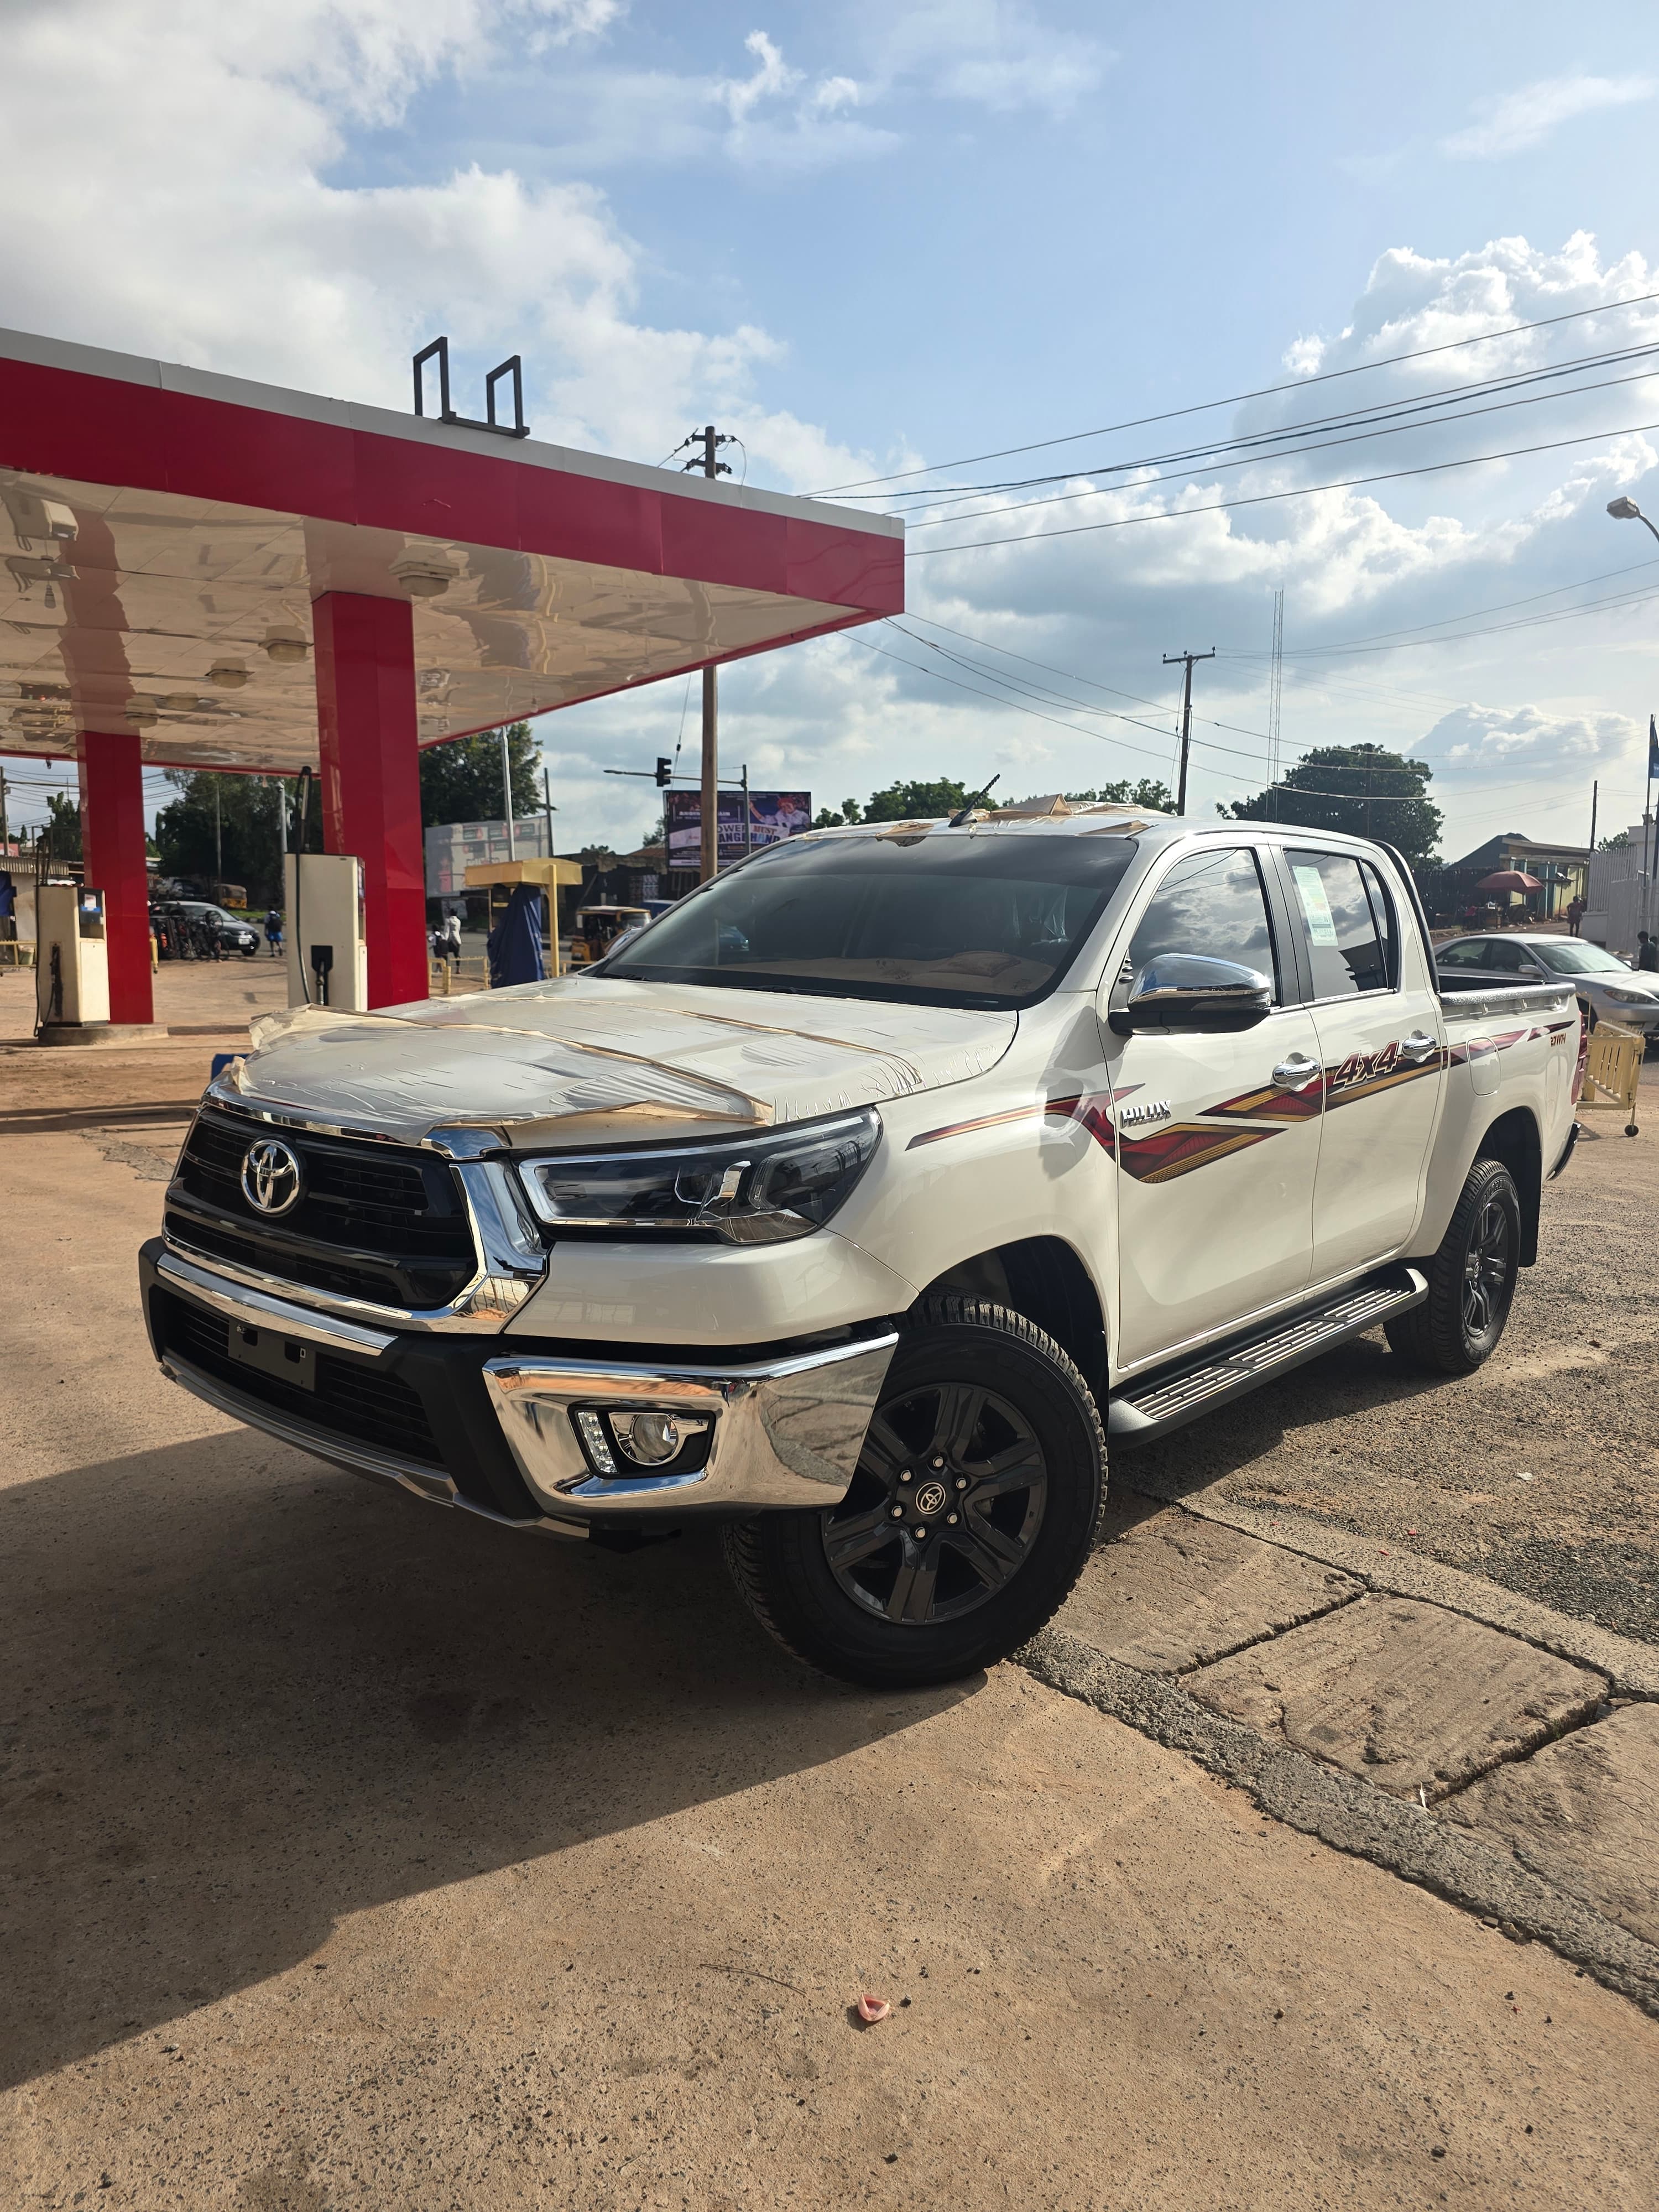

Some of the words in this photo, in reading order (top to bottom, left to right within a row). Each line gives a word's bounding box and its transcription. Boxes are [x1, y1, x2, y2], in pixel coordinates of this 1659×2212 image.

[717, 824, 745, 833] OWE
[754, 825, 778, 835] MUST
[718, 832, 745, 842] ANG
[1120, 1099, 1171, 1129] HILUX
